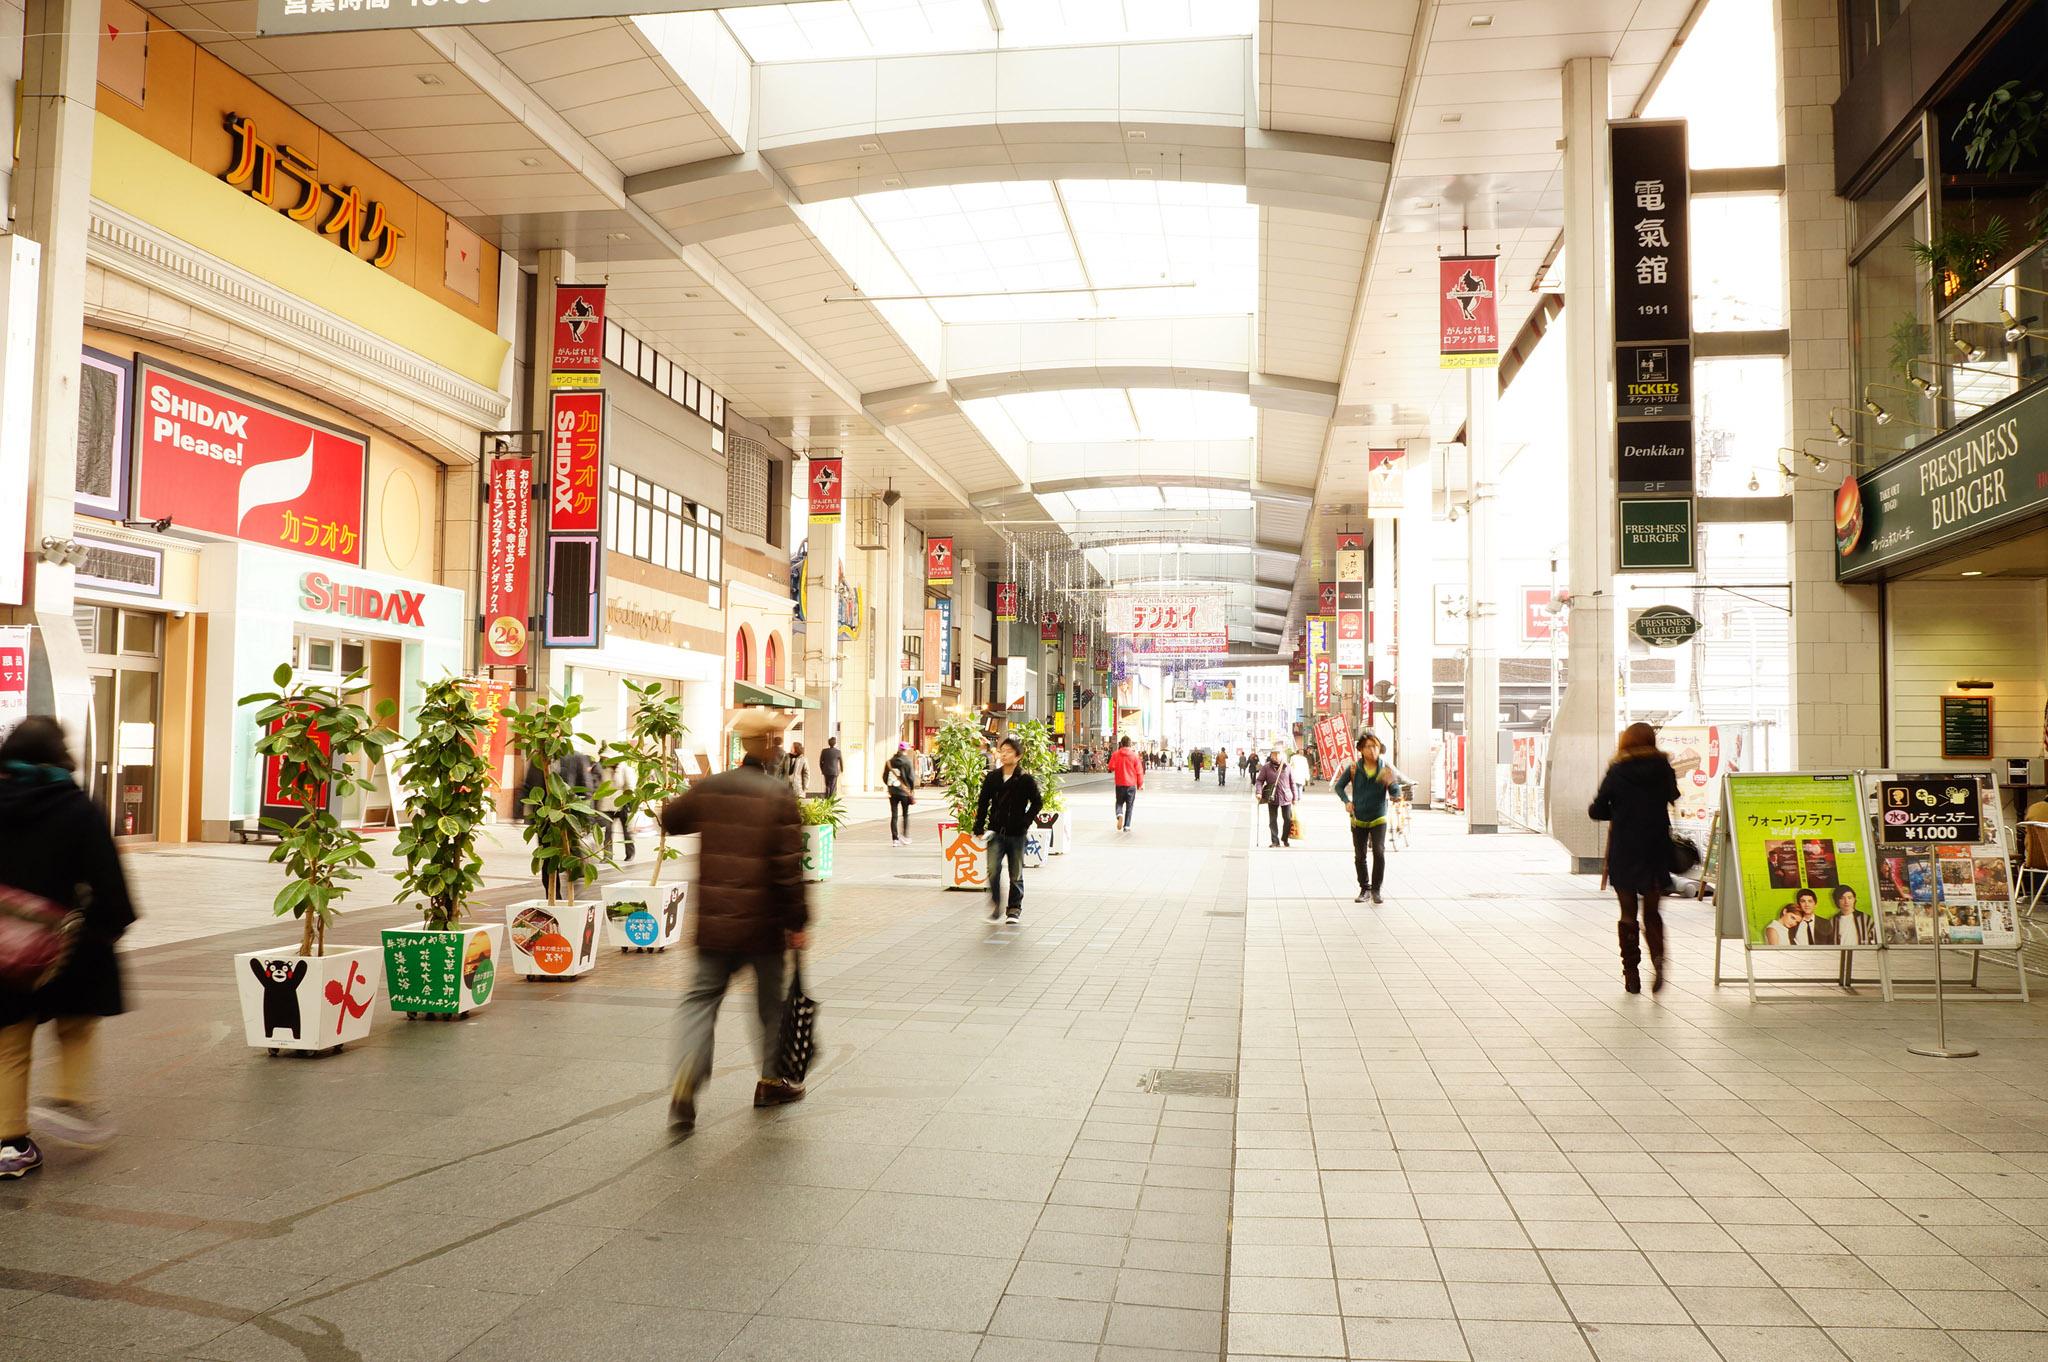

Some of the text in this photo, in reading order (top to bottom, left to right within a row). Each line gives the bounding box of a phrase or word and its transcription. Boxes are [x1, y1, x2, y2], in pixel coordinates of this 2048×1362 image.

[224, 117, 406, 269] カラオケ
[1638, 305, 1669, 315] 1911
[1443, 335, 1496, 344] ロアッソ熊本
[554, 356, 600, 364] ロアッソ熊本
[1628, 383, 1679, 394] TICKETS
[1629, 396, 1678, 404] チケットうりば
[150, 384, 248, 440] SHIDAX
[1644, 406, 1664, 416] 2F
[153, 415, 244, 466] Please!
[1624, 445, 1685, 457] Denkikan
[555, 410, 576, 515] SHIDAX
[574, 410, 600, 515] カラオケ
[1919, 418, 2019, 497] FRESHNESS
[1644, 482, 1666, 491] 2F
[1931, 468, 2008, 530] BURGER
[280, 509, 358, 555] カラオケ
[1625, 524, 1687, 534] FRESHNESS
[1632, 533, 1681, 543] BURGER
[304, 572, 426, 627] SHIDAX
[1133, 606, 1197, 629] テンガイ
[1641, 617, 1692, 627] FRESHNESS
[1646, 626, 1687, 635] BURGER
[1319, 662, 1330, 706] カラオケ
[1748, 814, 1846, 826] ウォールフラワー
[1909, 812, 1975, 823] レディースデー
[1905, 826, 1958, 840] ¥1,000
